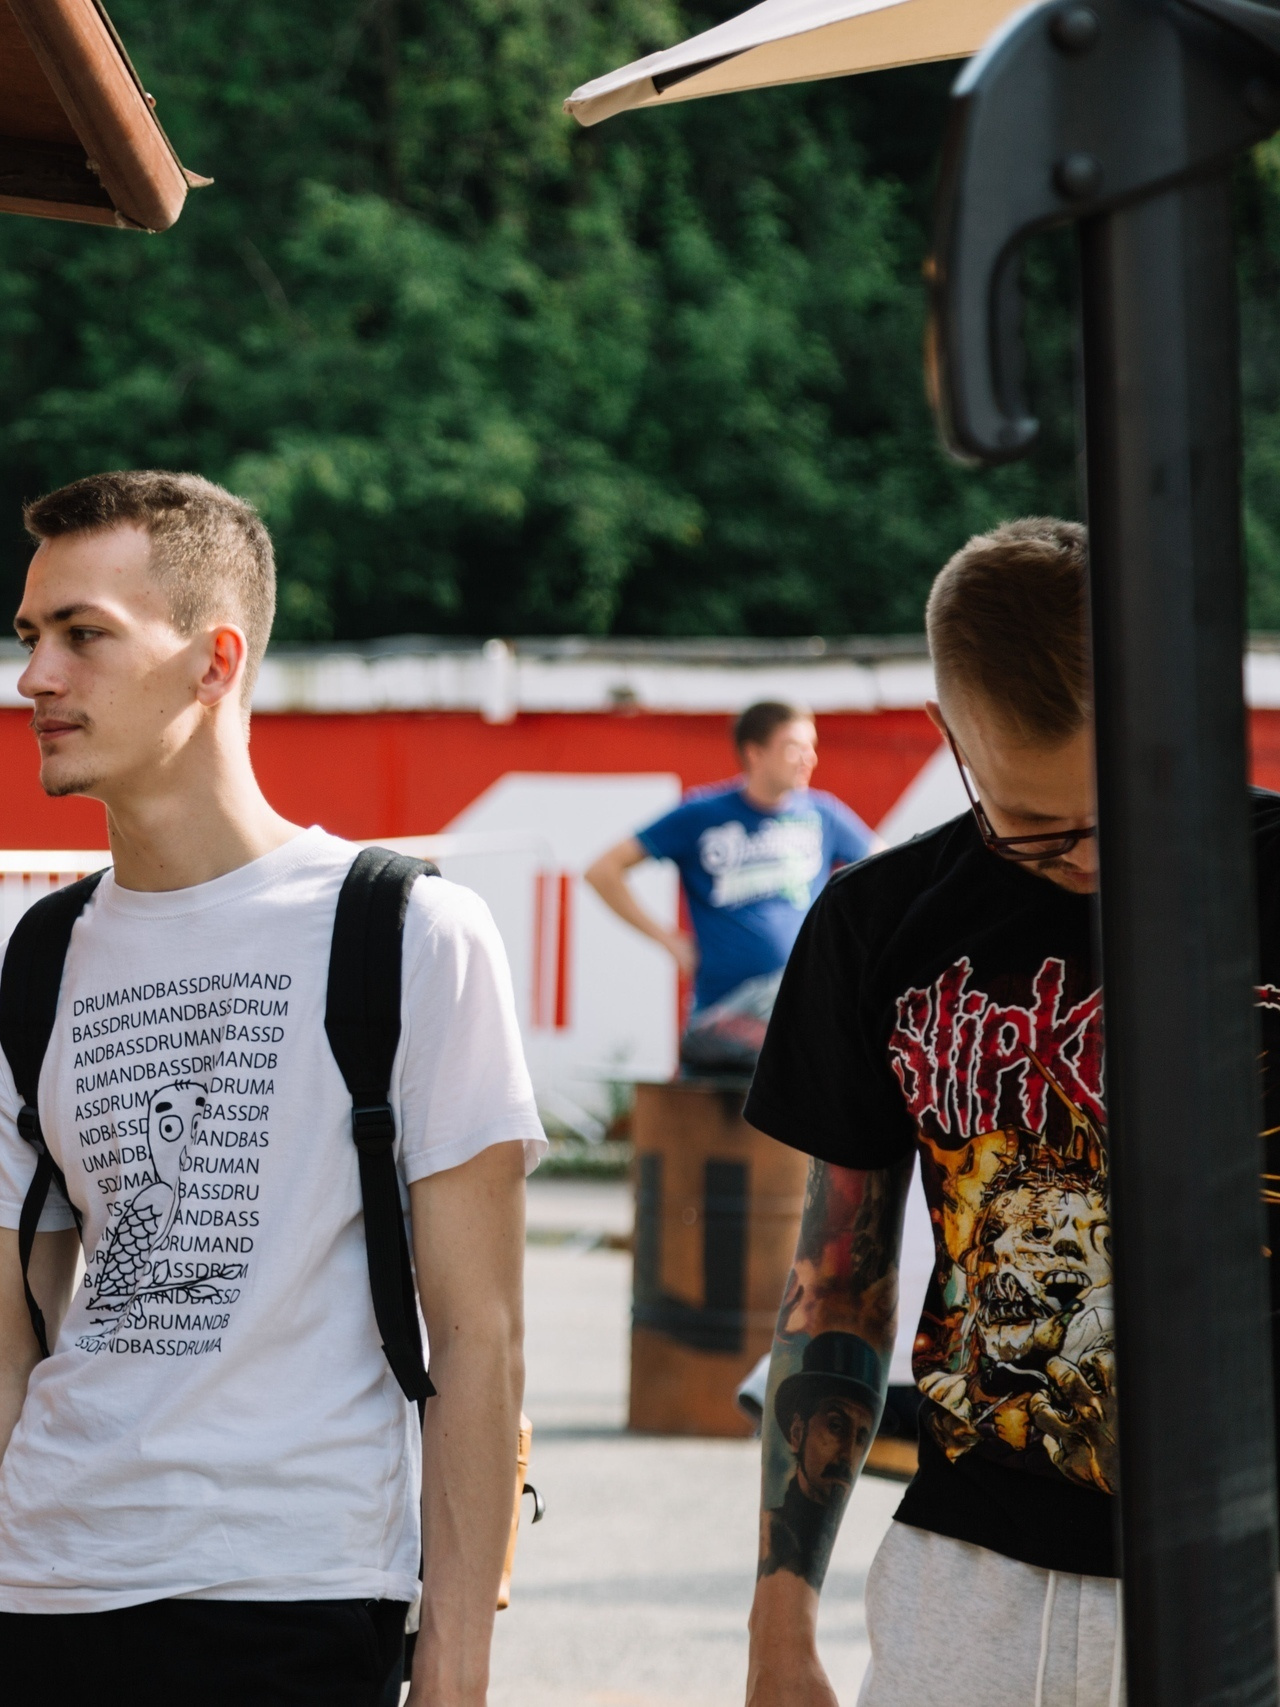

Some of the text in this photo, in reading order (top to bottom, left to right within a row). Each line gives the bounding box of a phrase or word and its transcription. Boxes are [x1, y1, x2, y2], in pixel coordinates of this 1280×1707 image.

[73, 972, 292, 1017] DRUMANDBASSDRUMAND
[72, 998, 289, 1043] BASSDRUMANDBASSDRUM
[74, 1024, 285, 1070] ANDBASSDRUMANBASSD
[202, 1103, 269, 1121] BASSDR
[178, 1182, 260, 1201] BASSDRU
